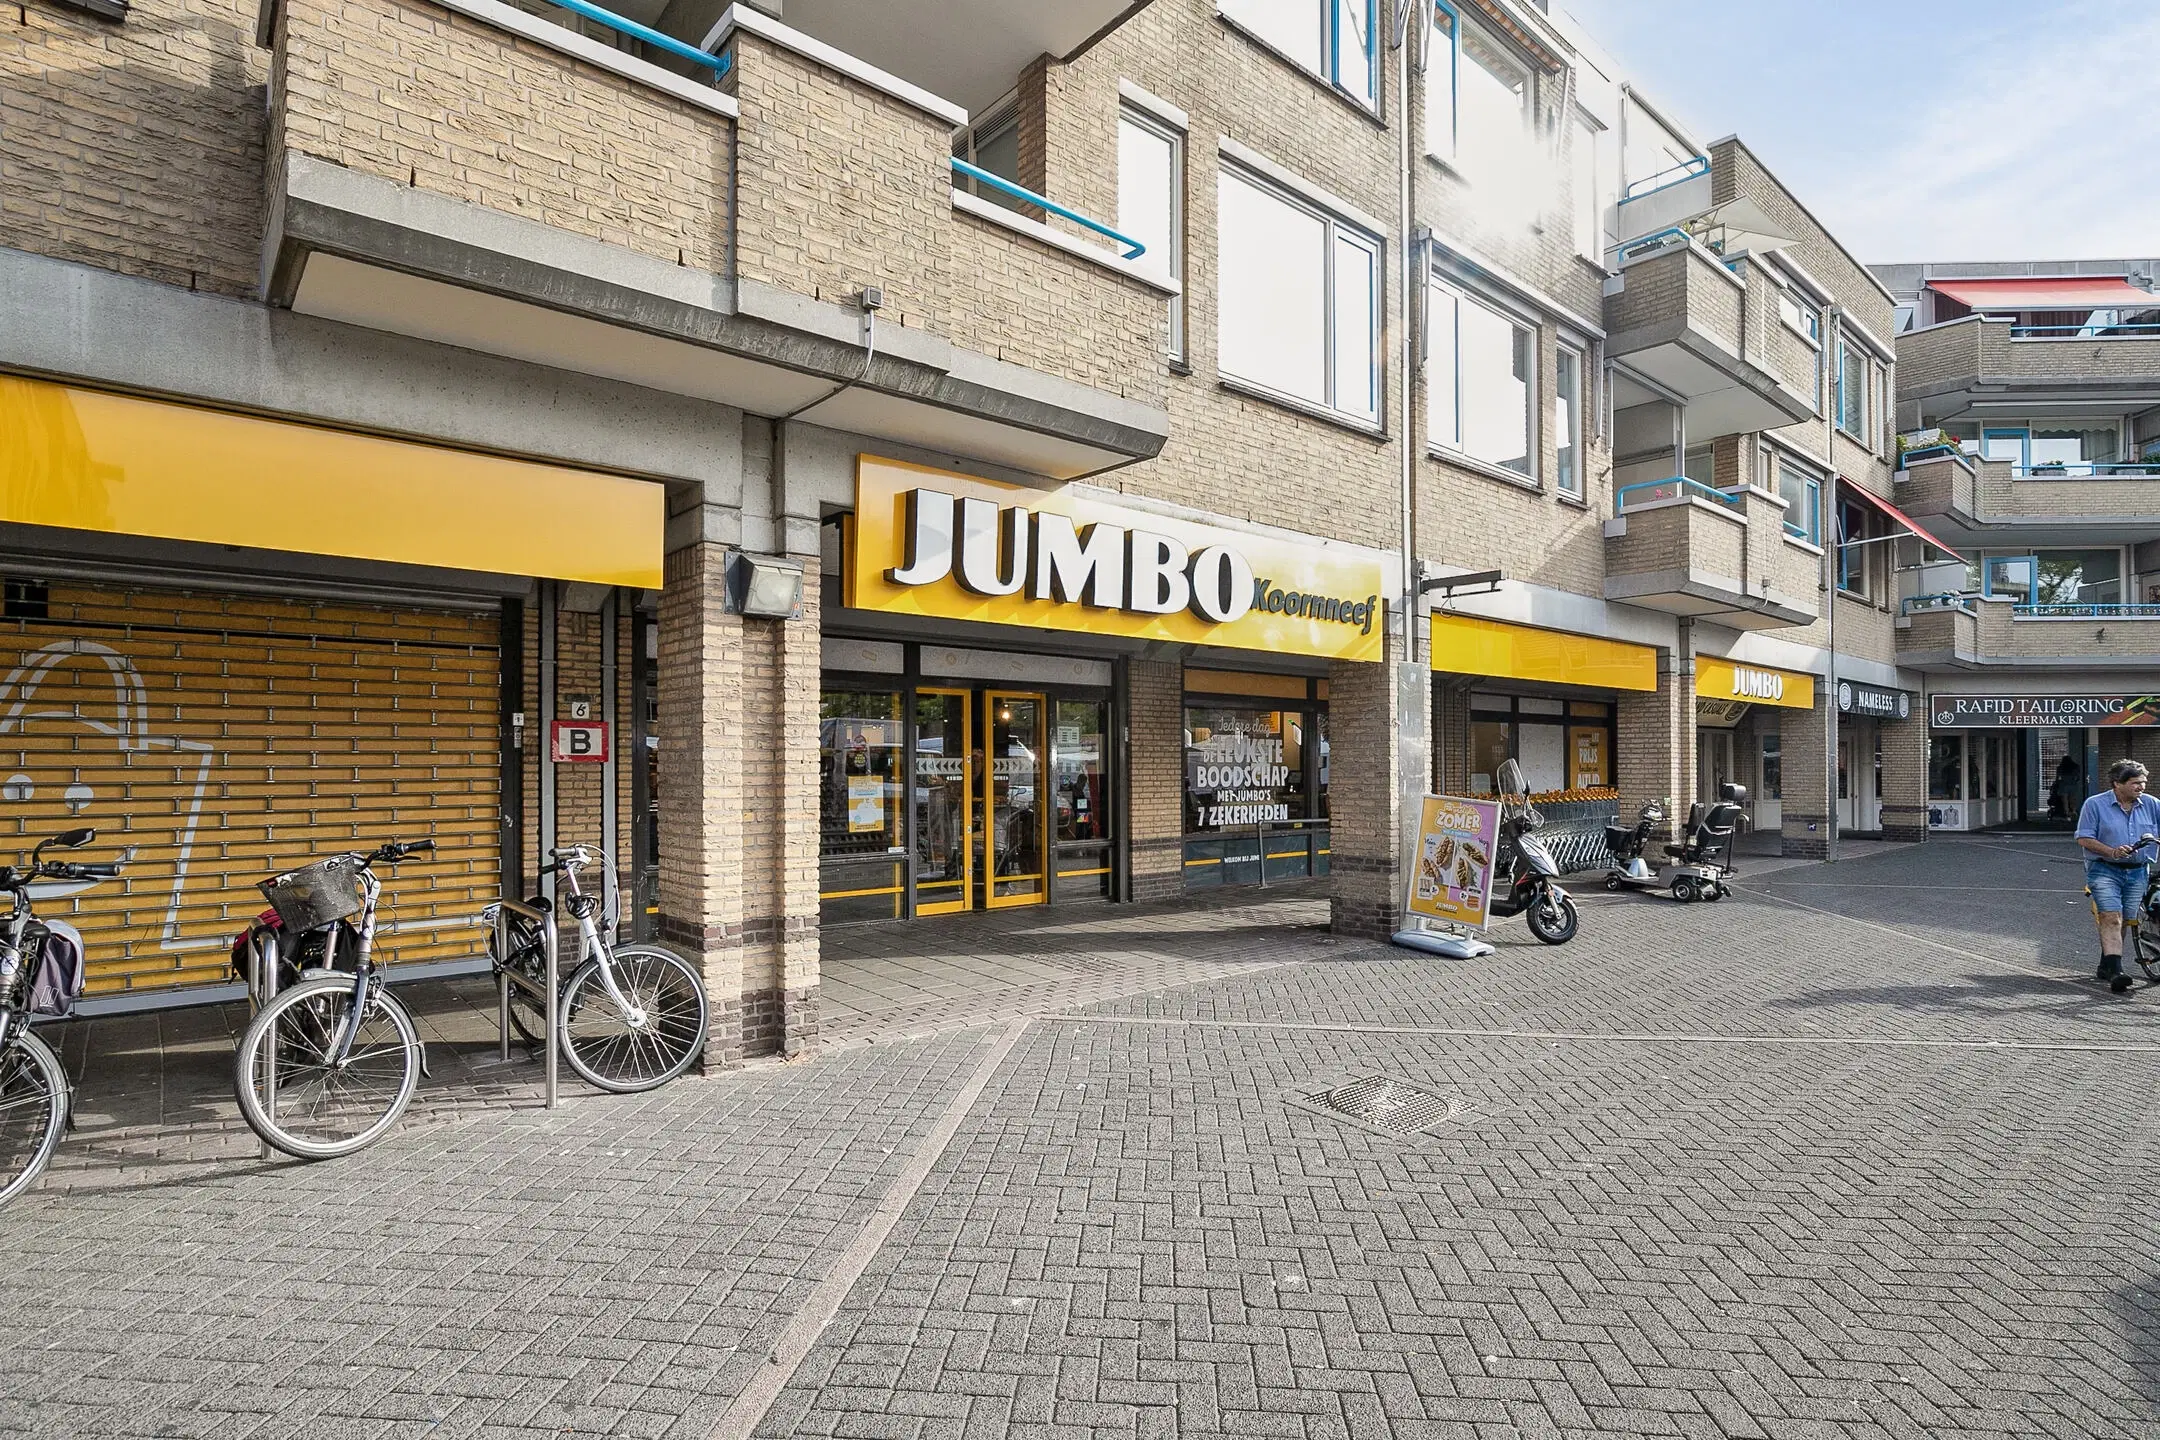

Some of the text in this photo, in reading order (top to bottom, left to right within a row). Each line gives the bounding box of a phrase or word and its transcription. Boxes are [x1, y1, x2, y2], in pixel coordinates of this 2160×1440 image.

[885, 487, 1377, 635] JUMBO Koornneef
[1732, 665, 1783, 701] JUMBO
[576, 704, 587, 717] 6
[1858, 690, 1893, 711] NAMELESS
[1955, 698, 2124, 714] RAFID TAILORING
[1252, 718, 1272, 737] dag
[1998, 715, 2085, 725] KLEERMAKER
[570, 729, 592, 754] B
[1217, 737, 1283, 764] LEUKSTE
[1197, 765, 1289, 788] BOODSCHAP
[1217, 789, 1271, 802] MET JUMBO'S
[1198, 804, 1288, 826] 7 ZEKERHEDEN
[1436, 810, 1481, 829] ZOMER
